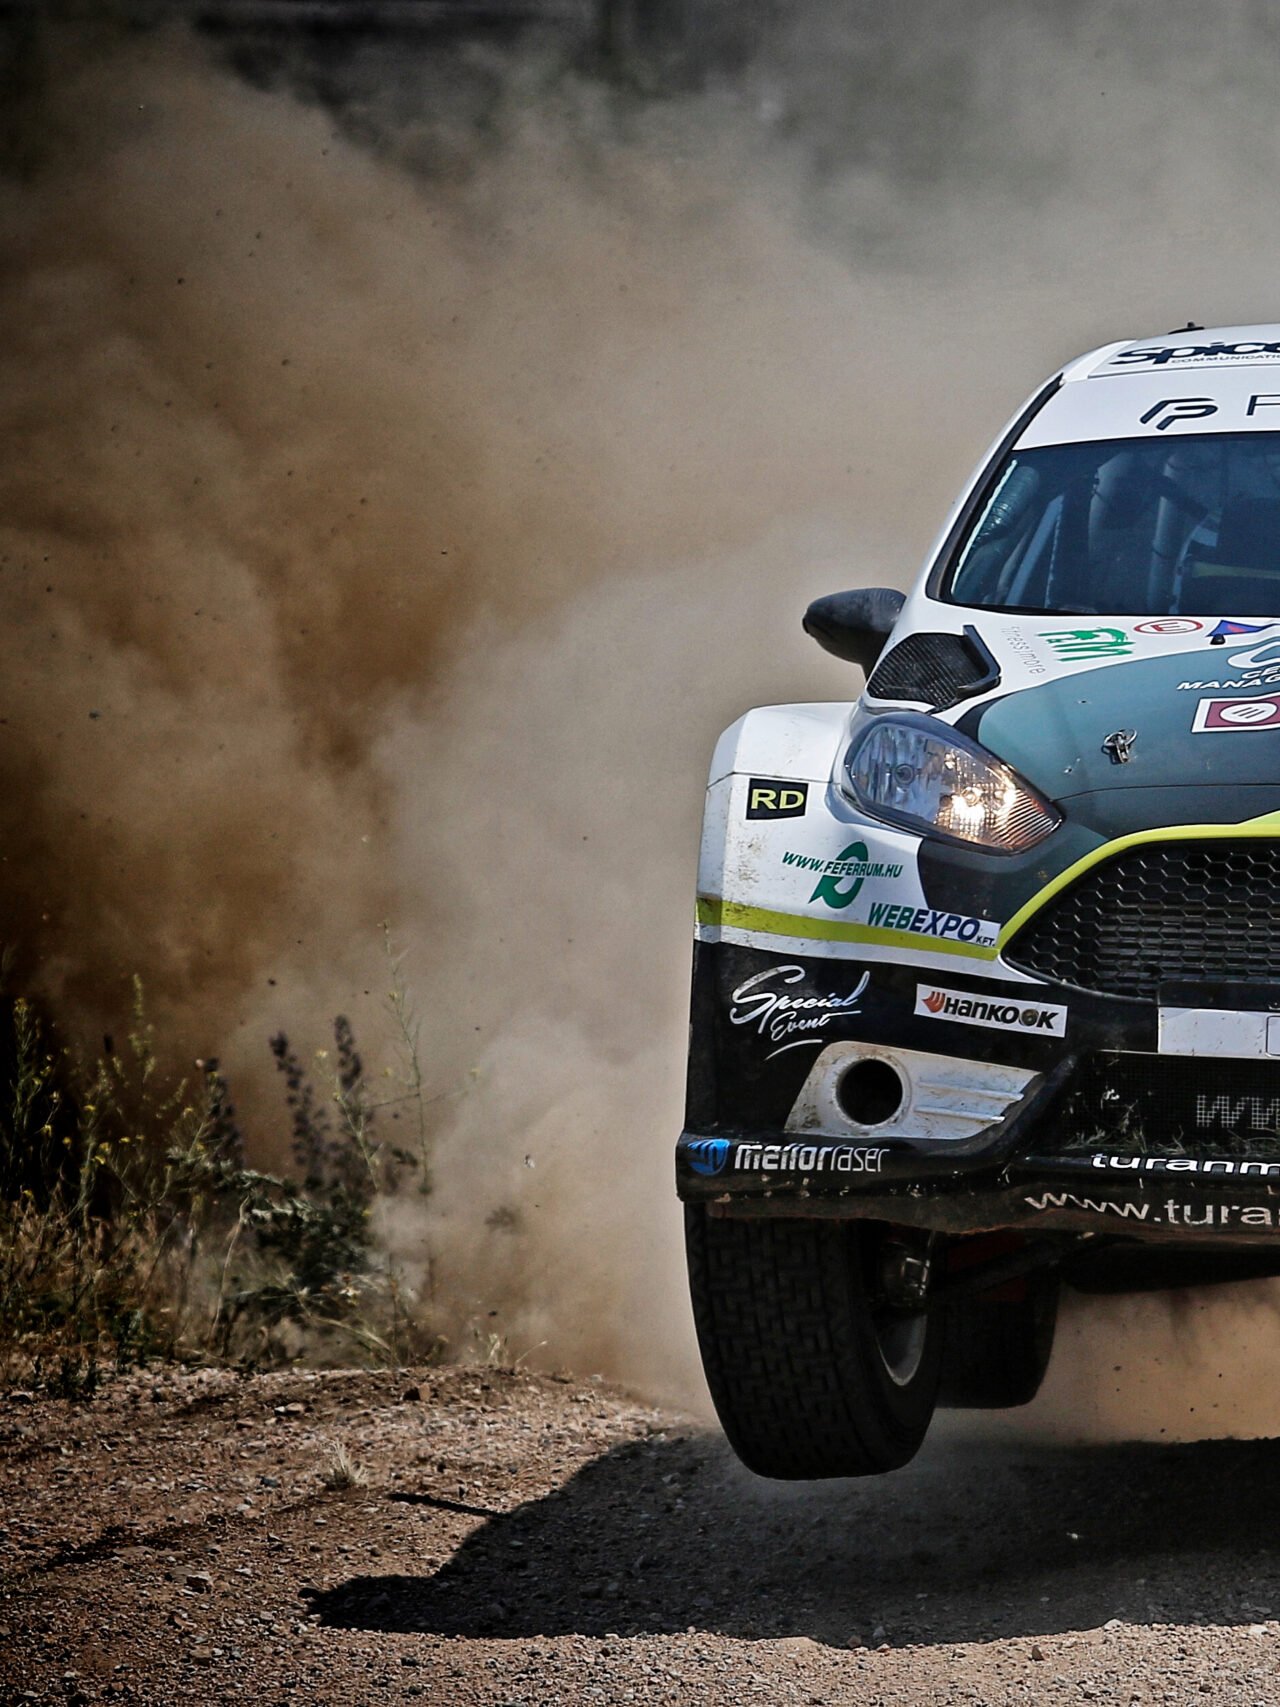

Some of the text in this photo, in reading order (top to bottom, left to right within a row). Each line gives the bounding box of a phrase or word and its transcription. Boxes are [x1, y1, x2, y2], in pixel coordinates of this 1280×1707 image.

[749, 788, 804, 811] RD
[782, 851, 904, 879] WWW.FEFERRUM.HU
[867, 901, 981, 942] WEBEXPO
[730, 965, 871, 1034] Special
[943, 997, 1059, 1030] HanKOK
[771, 1010, 862, 1041] Event
